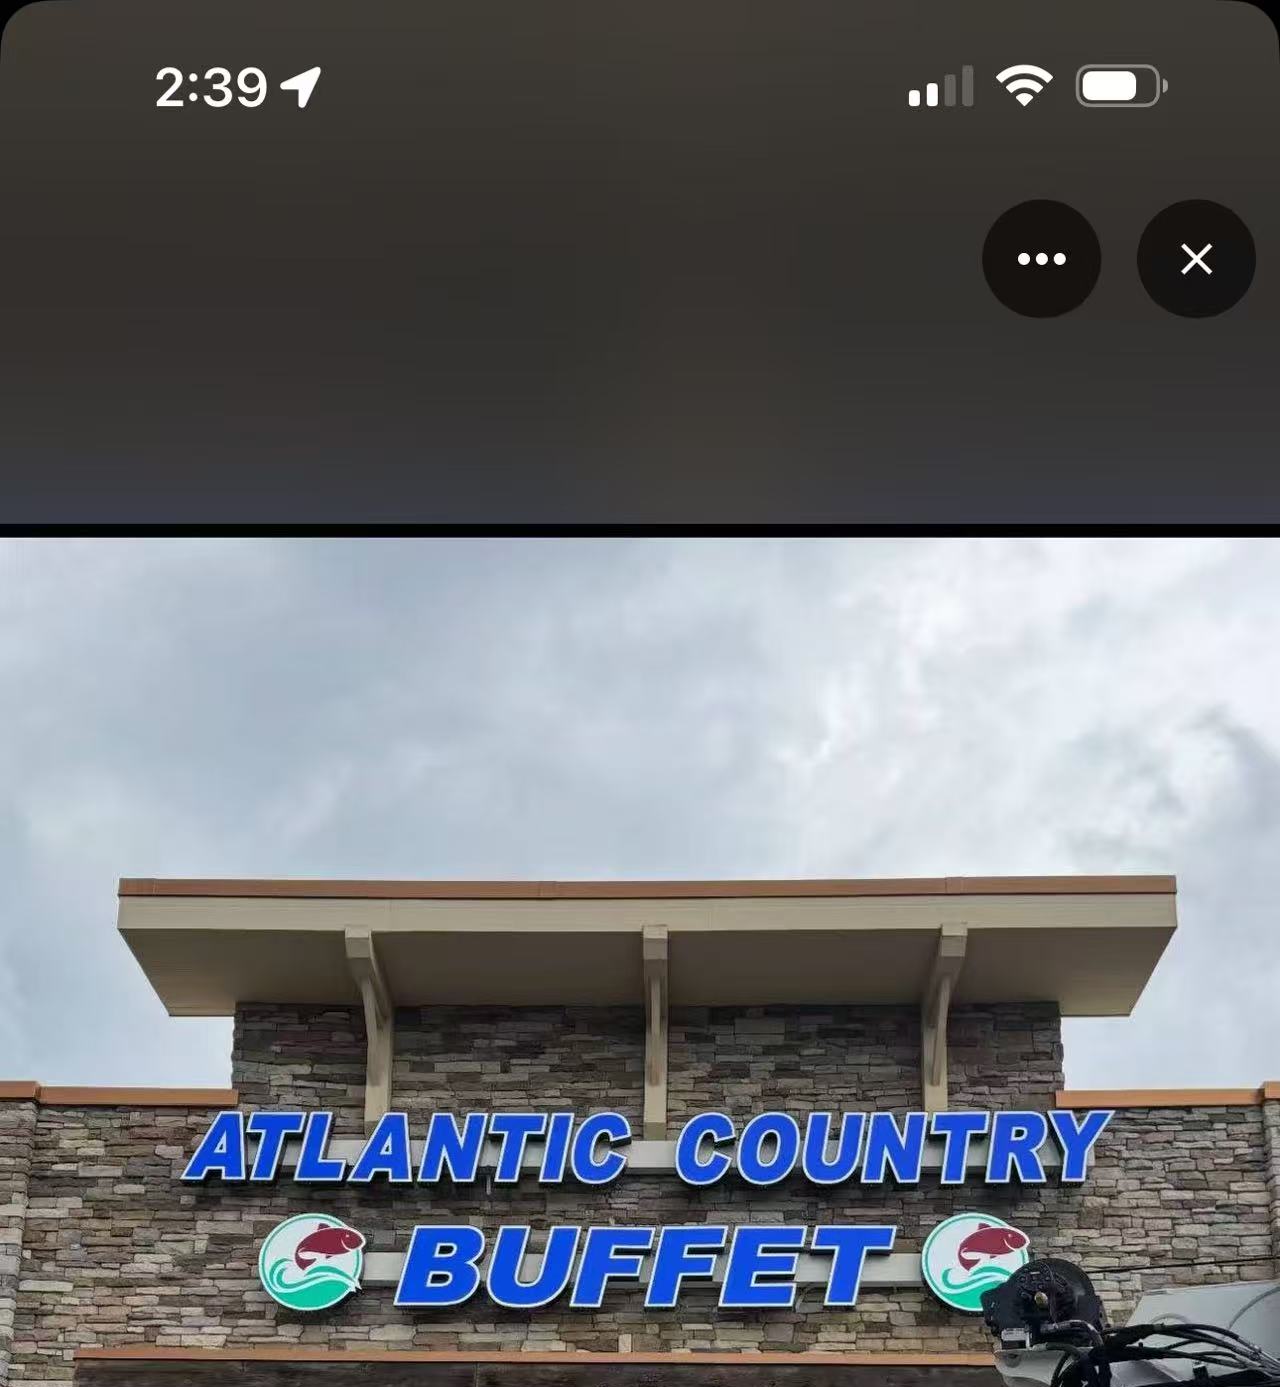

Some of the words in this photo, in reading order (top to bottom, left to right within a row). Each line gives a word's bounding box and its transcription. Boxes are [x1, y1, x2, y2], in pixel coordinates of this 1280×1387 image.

[180, 1111, 631, 1185] ATLANTIC
[675, 1110, 1115, 1186] COUNTRY
[394, 1225, 897, 1308] BUFFET
